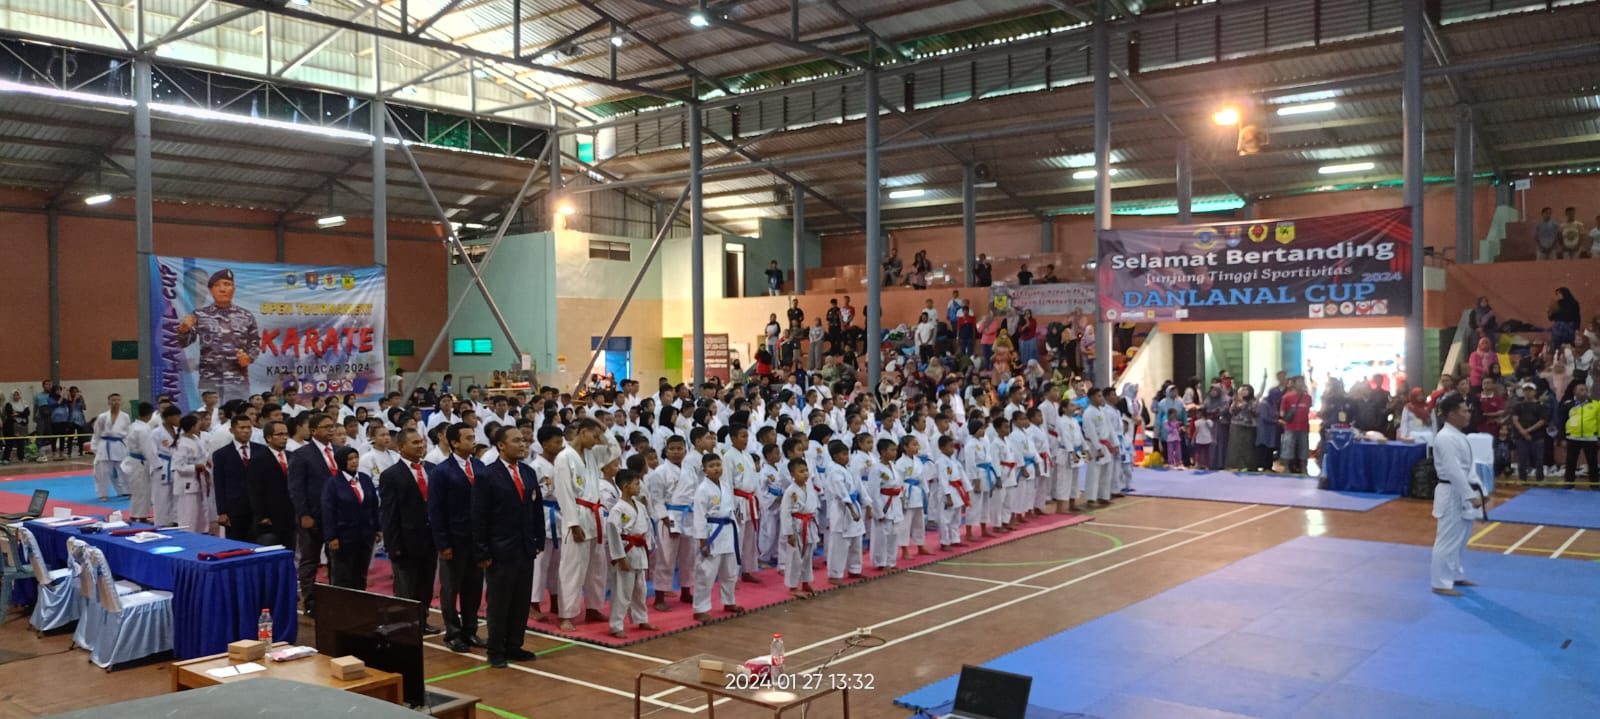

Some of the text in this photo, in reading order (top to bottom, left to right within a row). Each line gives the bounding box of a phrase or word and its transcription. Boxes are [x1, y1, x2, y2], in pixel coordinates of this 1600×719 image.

[1112, 240, 1394, 269] Selamat Bertanding
[160, 264, 177, 300] CUP
[1144, 265, 1353, 286] Junjung Tinggi Sportivitas
[1361, 271, 1402, 283] 2024
[1123, 282, 1376, 308] DANLANAL CUP
[260, 302, 293, 315] OPEN
[260, 326, 374, 358] KARATE
[344, 362, 370, 373] 2024
